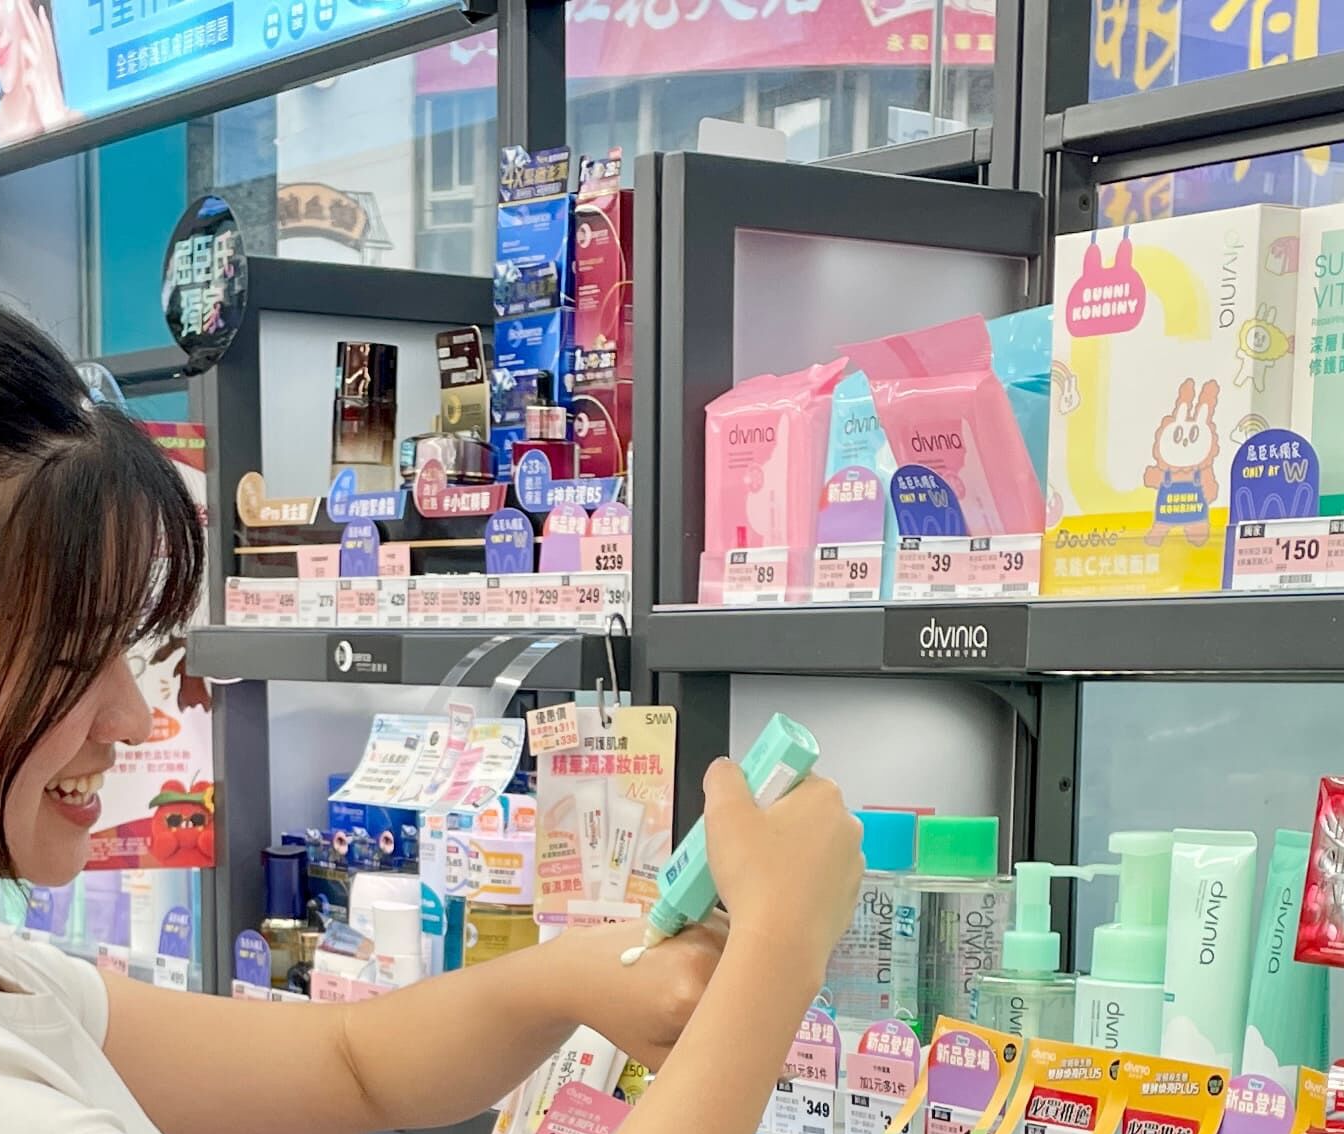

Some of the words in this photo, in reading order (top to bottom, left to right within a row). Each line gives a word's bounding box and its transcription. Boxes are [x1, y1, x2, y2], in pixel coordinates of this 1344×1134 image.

[1219, 228, 1244, 330] divinia
[728, 424, 776, 446] divinia
[911, 430, 962, 453] divinia
[1246, 441, 1302, 462] 屈臣氏獨家
[828, 479, 877, 502] 新品登場
[595, 555, 624, 571] $239
[919, 617, 989, 650] divinia
[536, 706, 568, 723] 優惠價
[645, 712, 673, 726] SANA
[584, 736, 629, 751] 呵護肌膚
[551, 754, 665, 777] 精華潤澤妝前乳
[1199, 880, 1228, 966] divinia
[1268, 886, 1294, 975] divinia
[866, 1029, 914, 1059] 新品登場
[936, 1041, 990, 1073] 新品登場
[1225, 1086, 1287, 1119] 新品登場
